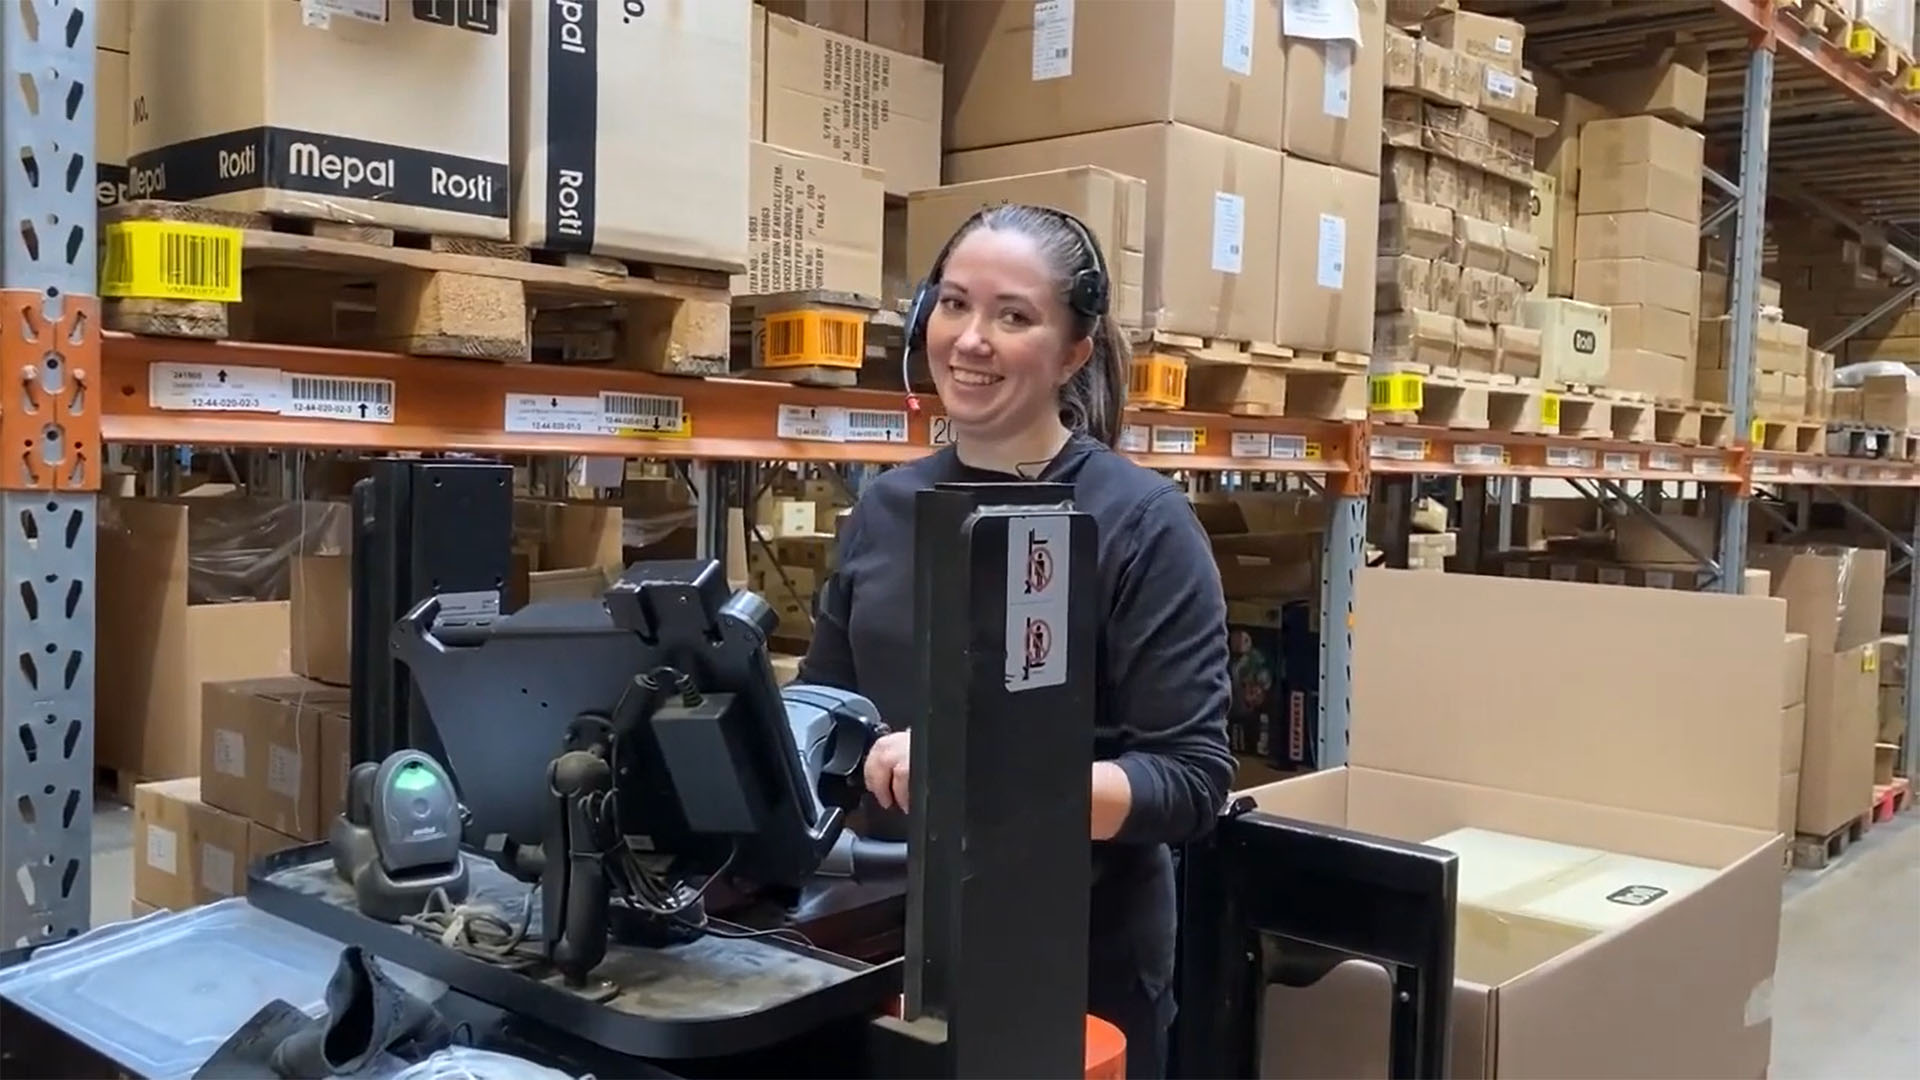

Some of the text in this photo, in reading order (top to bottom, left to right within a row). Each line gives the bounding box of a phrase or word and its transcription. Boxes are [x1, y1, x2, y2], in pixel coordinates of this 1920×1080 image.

[824, 39, 833, 79] IMPORTED
[834, 41, 843, 72] CARTON
[844, 44, 852, 82] QUANTITY
[872, 53, 881, 79] ORDER
[881, 55, 890, 74] ITEM
[862, 50, 871, 100] DESCRIPTION
[844, 82, 852, 97] PER
[852, 48, 862, 149] OVERSIZE MRS RUDOLF 2021
[862, 101, 870, 111] OF
[219, 144, 256, 180] Rosti
[843, 151, 851, 162] PC
[289, 142, 492, 203] Mepal Rosti
[796, 168, 805, 182] PC
[558, 168, 584, 235] Rosti
[784, 185, 793, 205] 2021
[783, 206, 792, 237] RUDOLF
[772, 228, 781, 239] OF
[783, 239, 791, 257] MRS
[795, 242, 803, 258] PER
[749, 273, 759, 294] ITEM
[377, 405, 389, 415] 95
